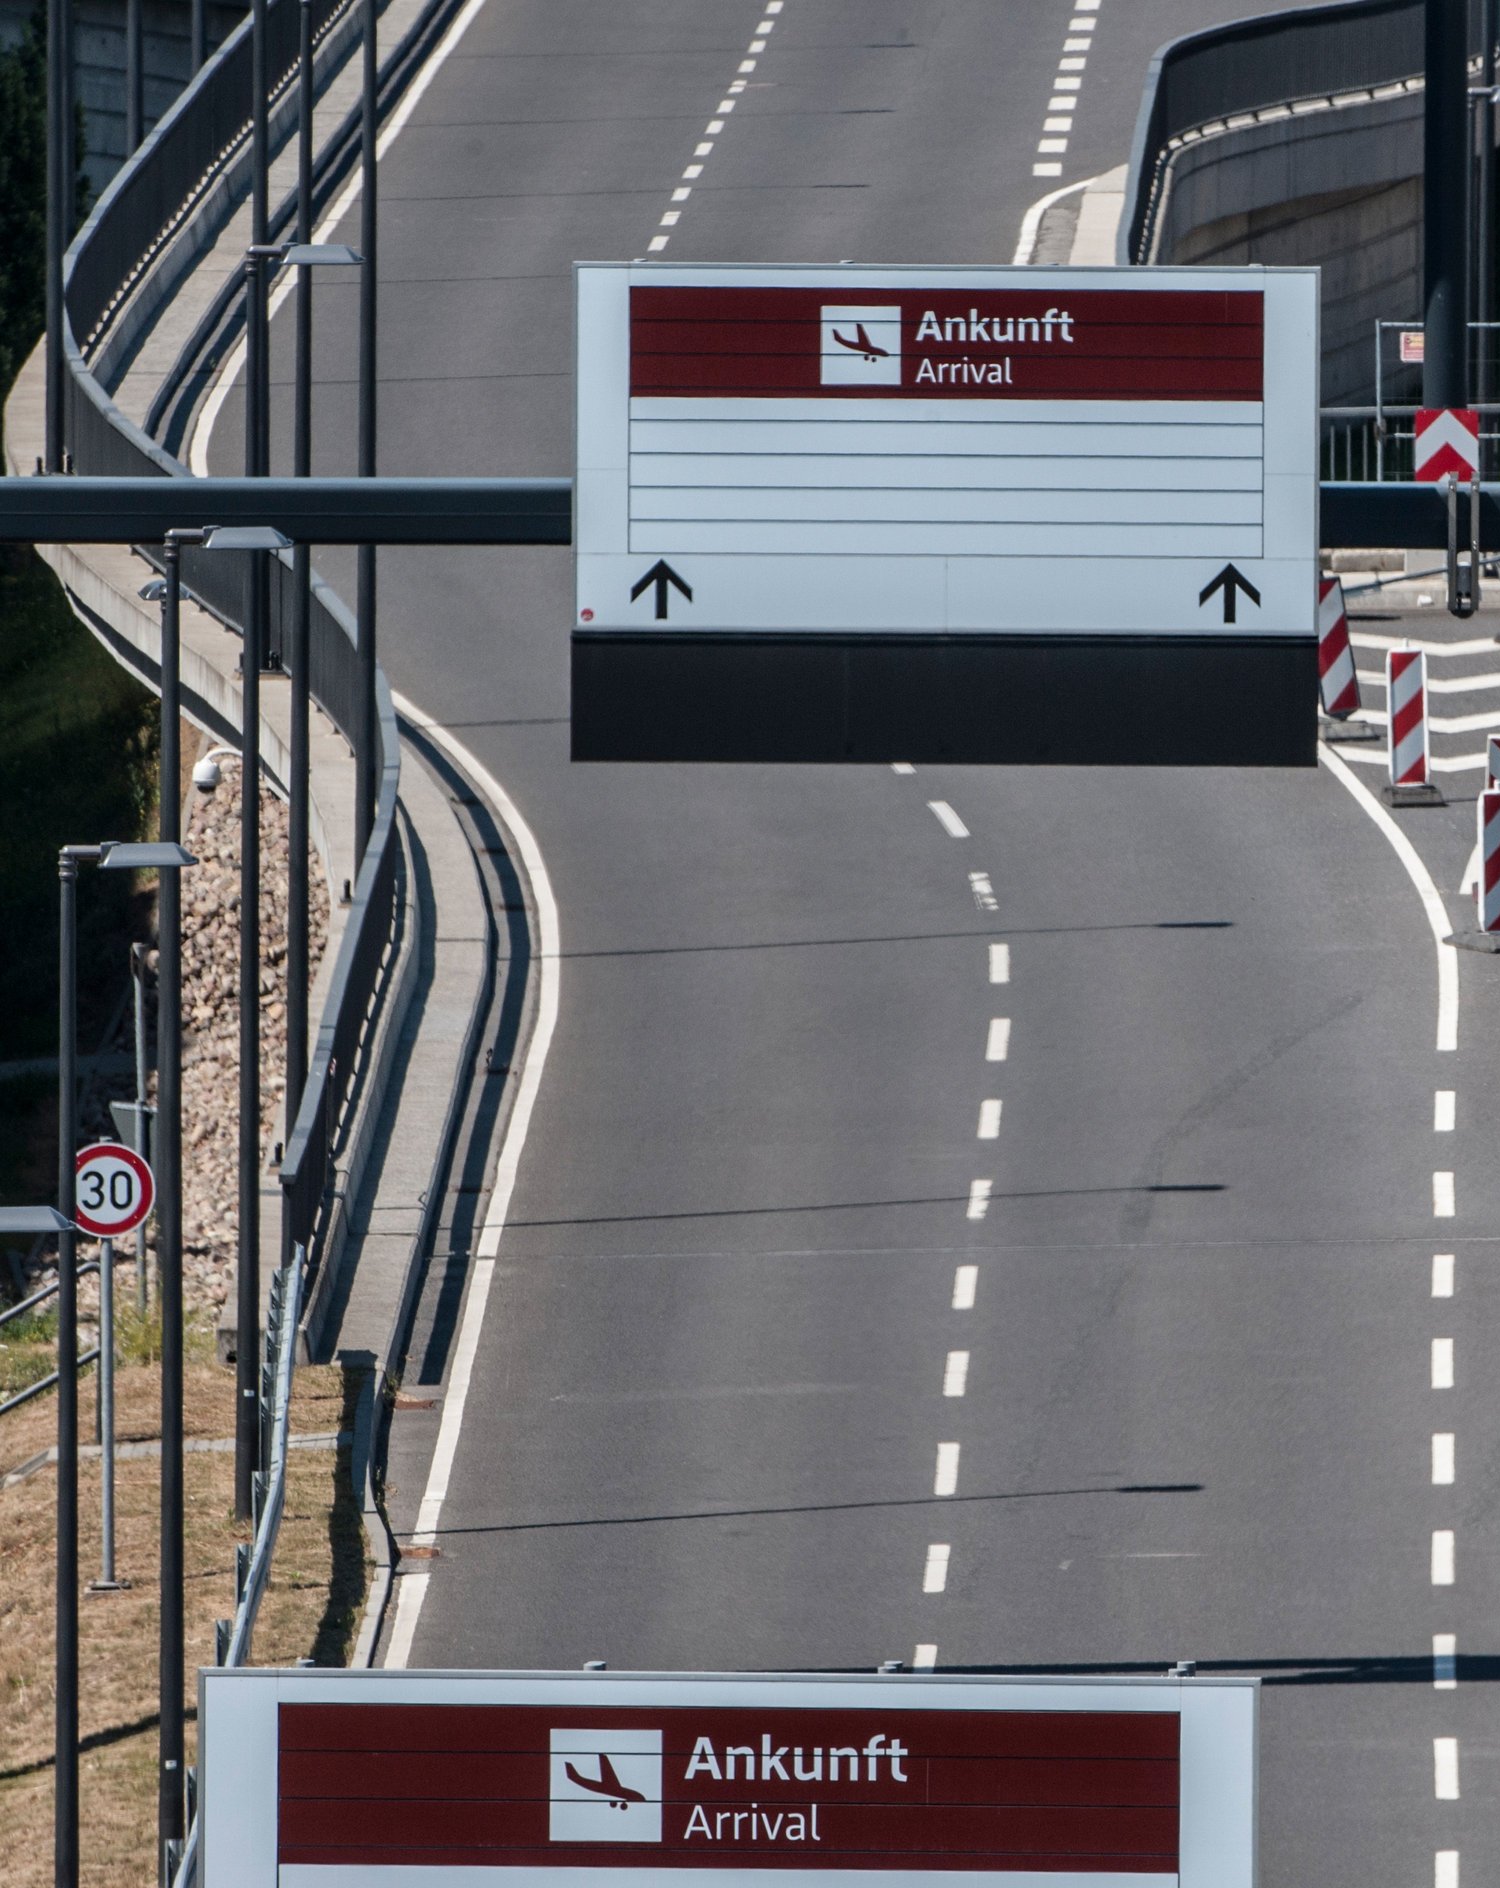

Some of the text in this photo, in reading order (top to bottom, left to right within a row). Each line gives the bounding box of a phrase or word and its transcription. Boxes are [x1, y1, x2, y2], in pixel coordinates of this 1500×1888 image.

[915, 308, 1074, 342] Ankunft
[916, 357, 1013, 384] Arrival
[82, 1171, 133, 1210] 30
[685, 1733, 908, 1782] Ankunft
[684, 1803, 821, 1841] Arrival
